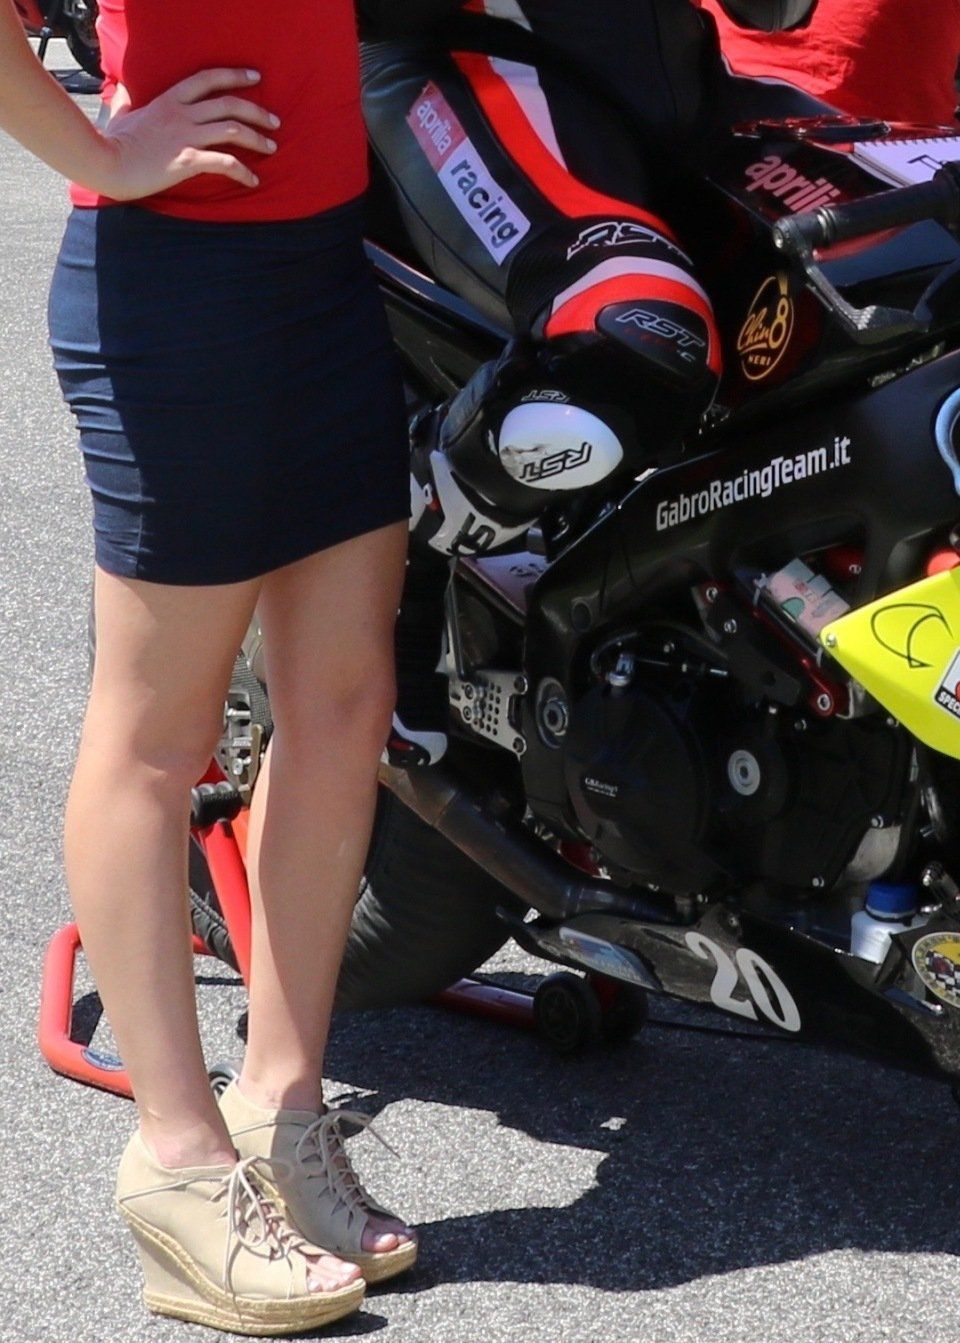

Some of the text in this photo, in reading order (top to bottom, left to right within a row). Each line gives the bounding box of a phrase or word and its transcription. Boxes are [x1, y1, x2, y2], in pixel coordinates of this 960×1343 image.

[416, 101, 452, 156] aprilia
[450, 159, 519, 249] racing
[745, 155, 842, 213] aprili
[615, 308, 706, 348] RST
[518, 441, 593, 483] RST
[656, 436, 851, 532] GabroRacingTeam.it
[685, 931, 802, 1032] 20
